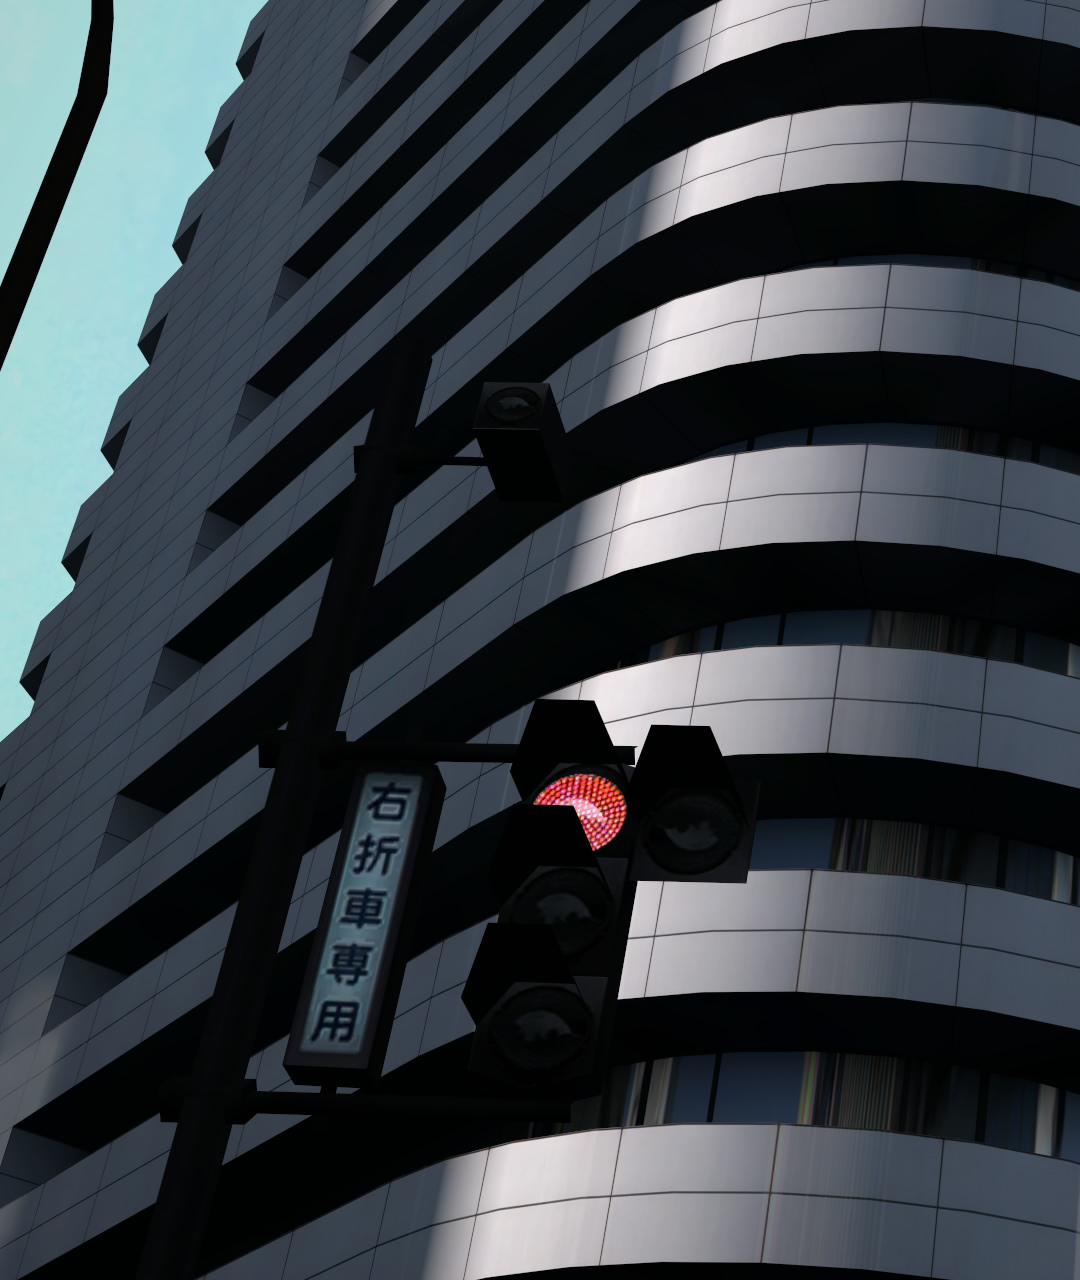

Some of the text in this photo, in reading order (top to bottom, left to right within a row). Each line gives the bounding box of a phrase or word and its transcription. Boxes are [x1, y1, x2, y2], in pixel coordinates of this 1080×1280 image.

[310, 782, 412, 1043] 右折車専用
